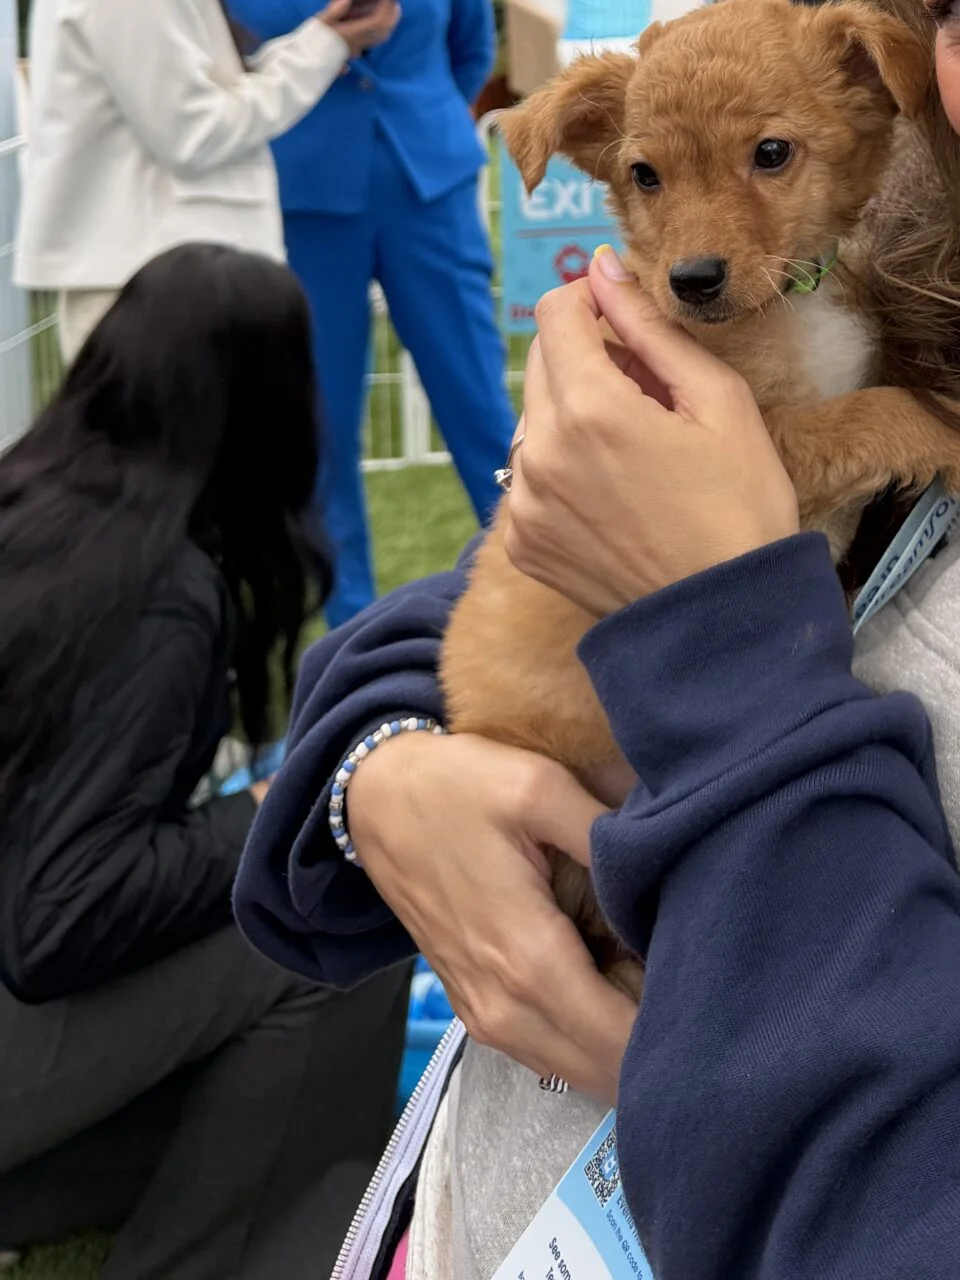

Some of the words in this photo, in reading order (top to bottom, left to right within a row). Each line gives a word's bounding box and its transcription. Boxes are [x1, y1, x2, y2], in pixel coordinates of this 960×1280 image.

[520, 178, 607, 219] EXI
[549, 1237, 561, 1261] See
[606, 1209, 618, 1231] Scan
[621, 1240, 630, 1254] QR
[626, 1252, 639, 1273] code
